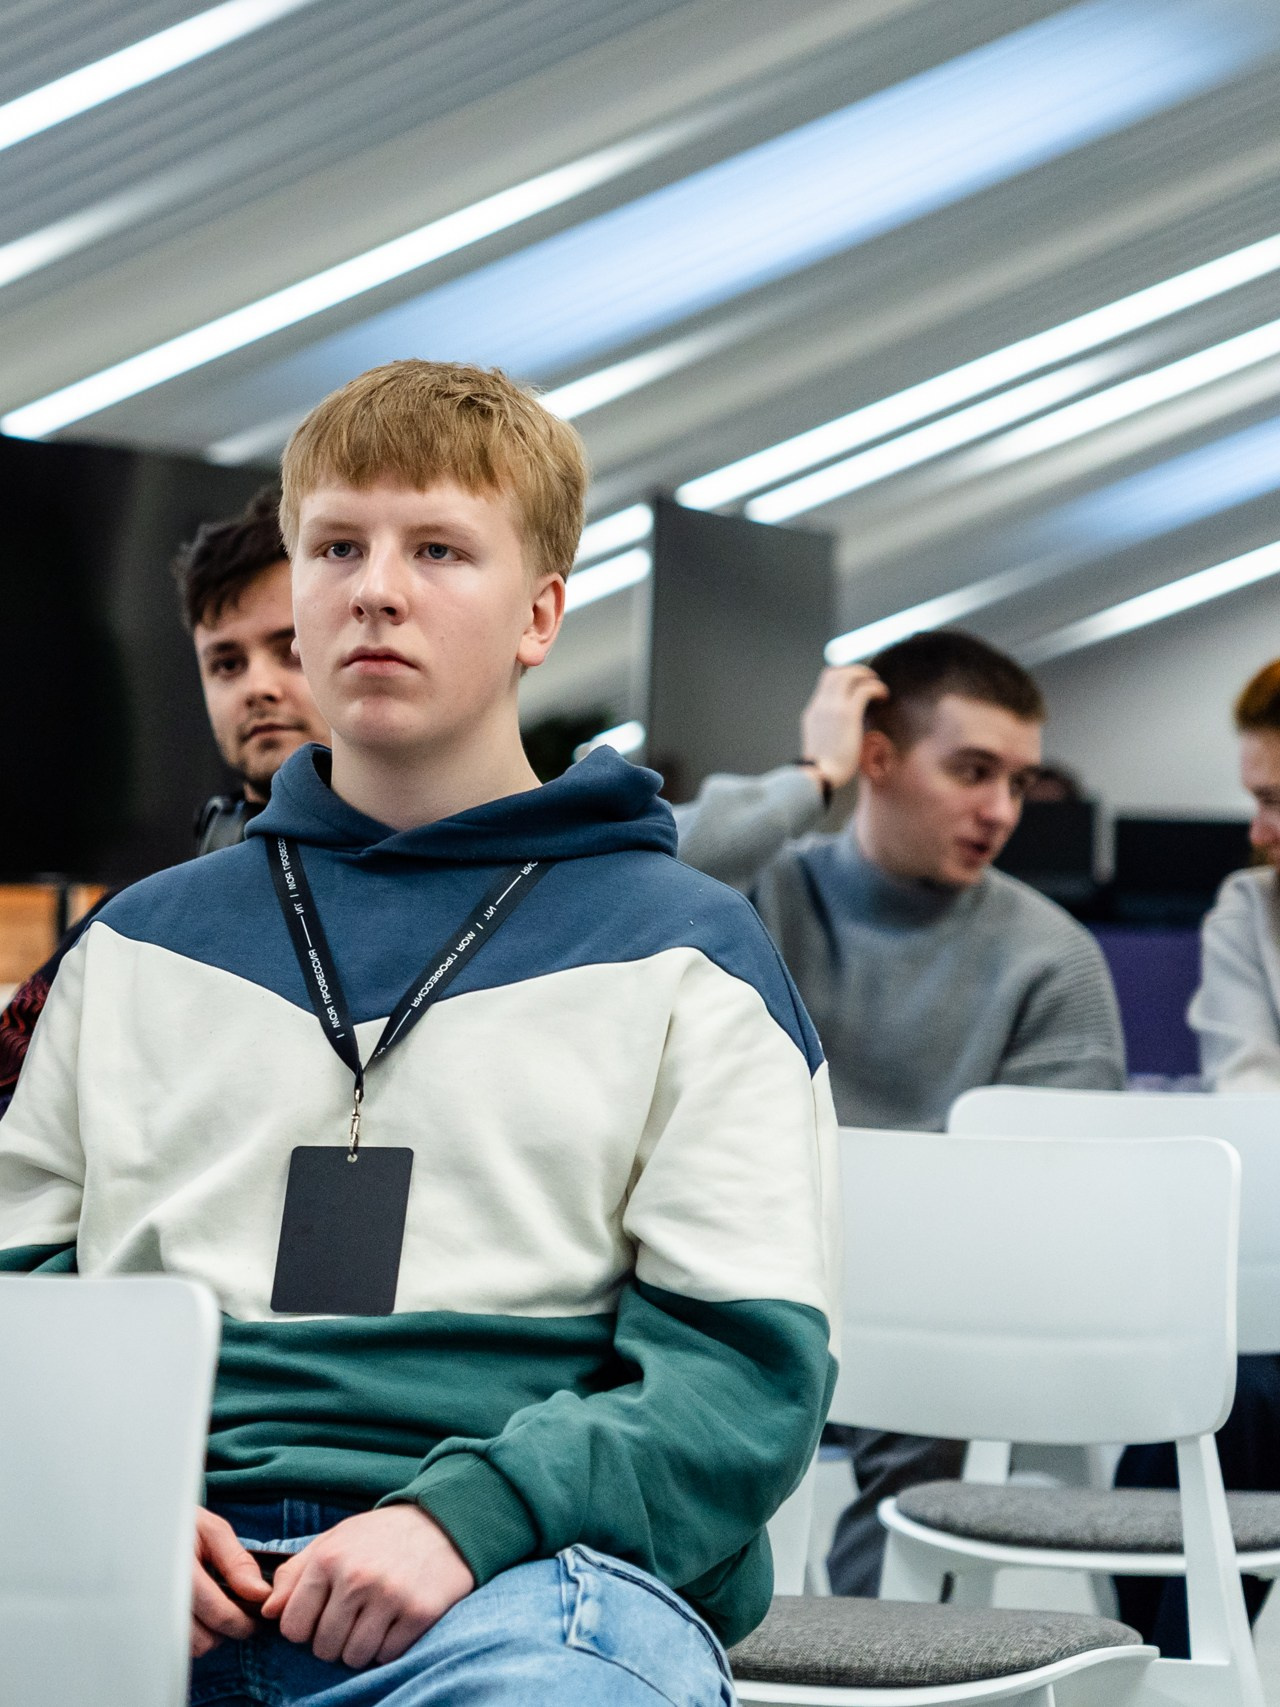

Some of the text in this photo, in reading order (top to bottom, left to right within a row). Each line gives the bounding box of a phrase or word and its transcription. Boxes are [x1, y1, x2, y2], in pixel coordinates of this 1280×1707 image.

[285, 871, 297, 890] МОЯ
[456, 930, 476, 952] МОЯ
[308, 948, 332, 1005] ПРОФЕССИЯ
[410, 952, 458, 1008] ПРОФЕССИЯ
[327, 1005, 341, 1029] МОЯ
